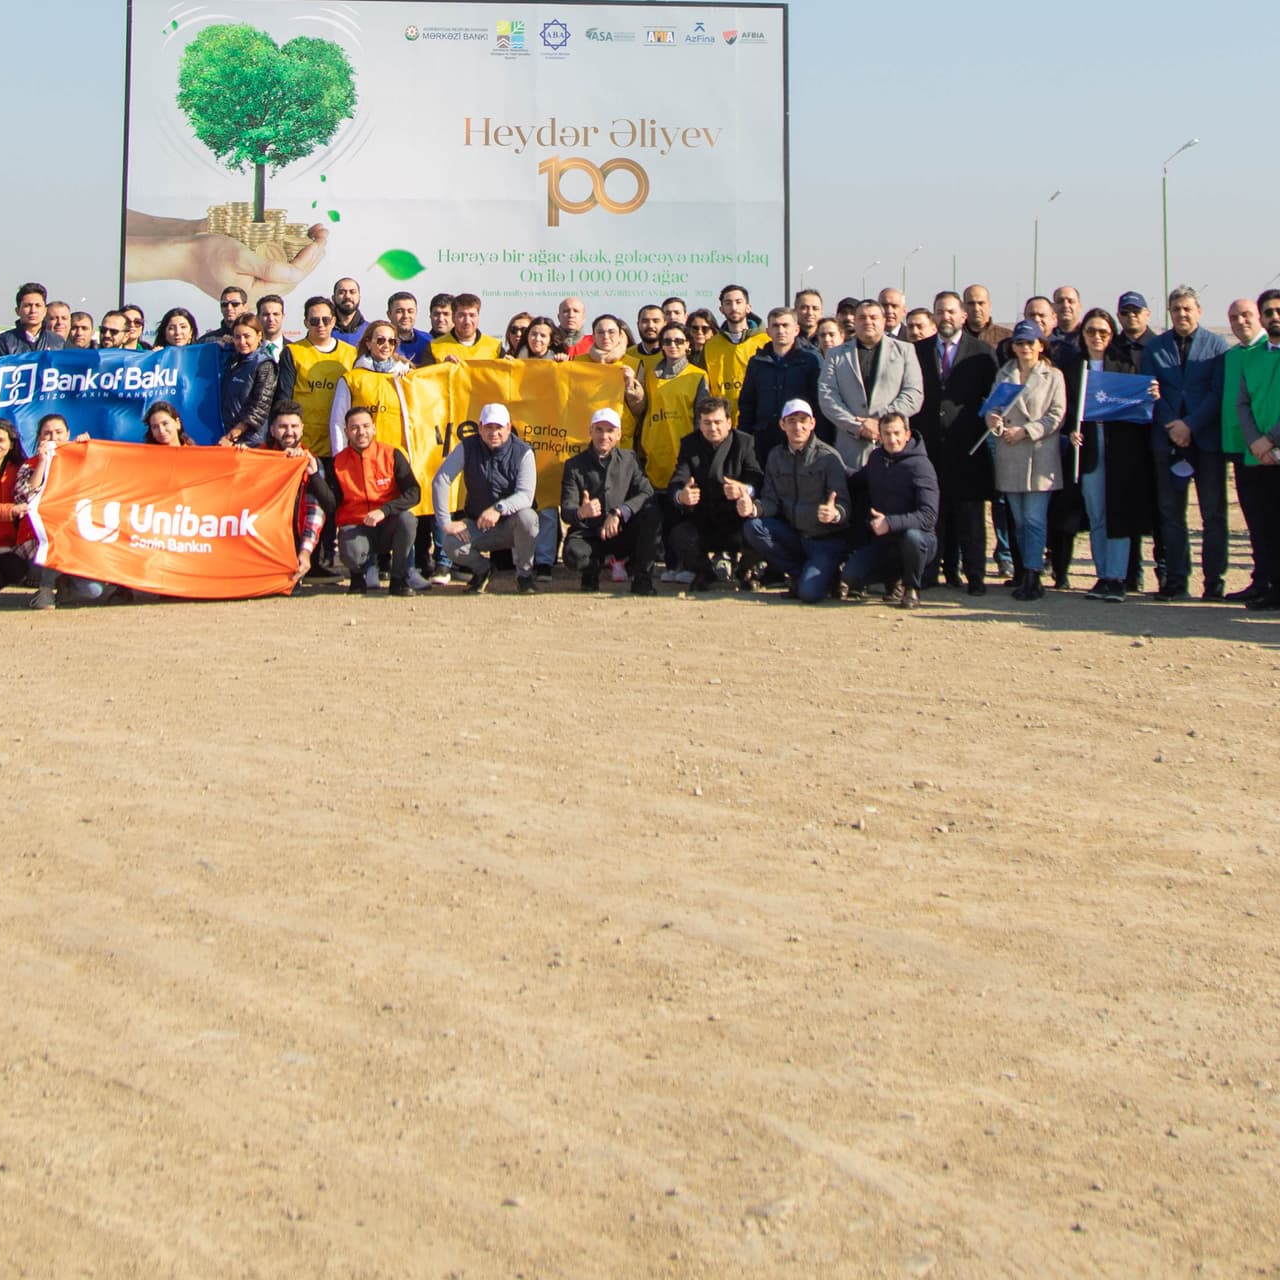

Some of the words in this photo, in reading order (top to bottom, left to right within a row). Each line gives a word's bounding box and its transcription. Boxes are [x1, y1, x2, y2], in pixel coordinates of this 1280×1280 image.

[545, 30, 565, 39] ABA
[591, 31, 613, 42] ASA
[684, 34, 716, 44] AzFina
[463, 117, 599, 154] Heydər
[609, 118, 722, 155] Əliyev
[538, 155, 650, 227] 100
[437, 249, 499, 266] Hərəyə
[502, 248, 525, 263] bir
[528, 249, 566, 266] ağac
[614, 249, 687, 267] gələcəyə
[690, 249, 734, 264] nəfəs
[736, 249, 769, 267] olaq
[519, 269, 543, 283] On
[546, 268, 566, 283] ilə
[651, 270, 689, 285] ağac
[41, 367, 99, 392] Bank
[100, 368, 124, 390] of
[124, 364, 178, 390] Baku
[307, 378, 335, 392] yelo
[366, 400, 387, 413] elo
[434, 419, 519, 458] ye
[523, 424, 568, 438] parlaq
[129, 503, 259, 538] Unibank
[167, 537, 212, 553] Bankın
